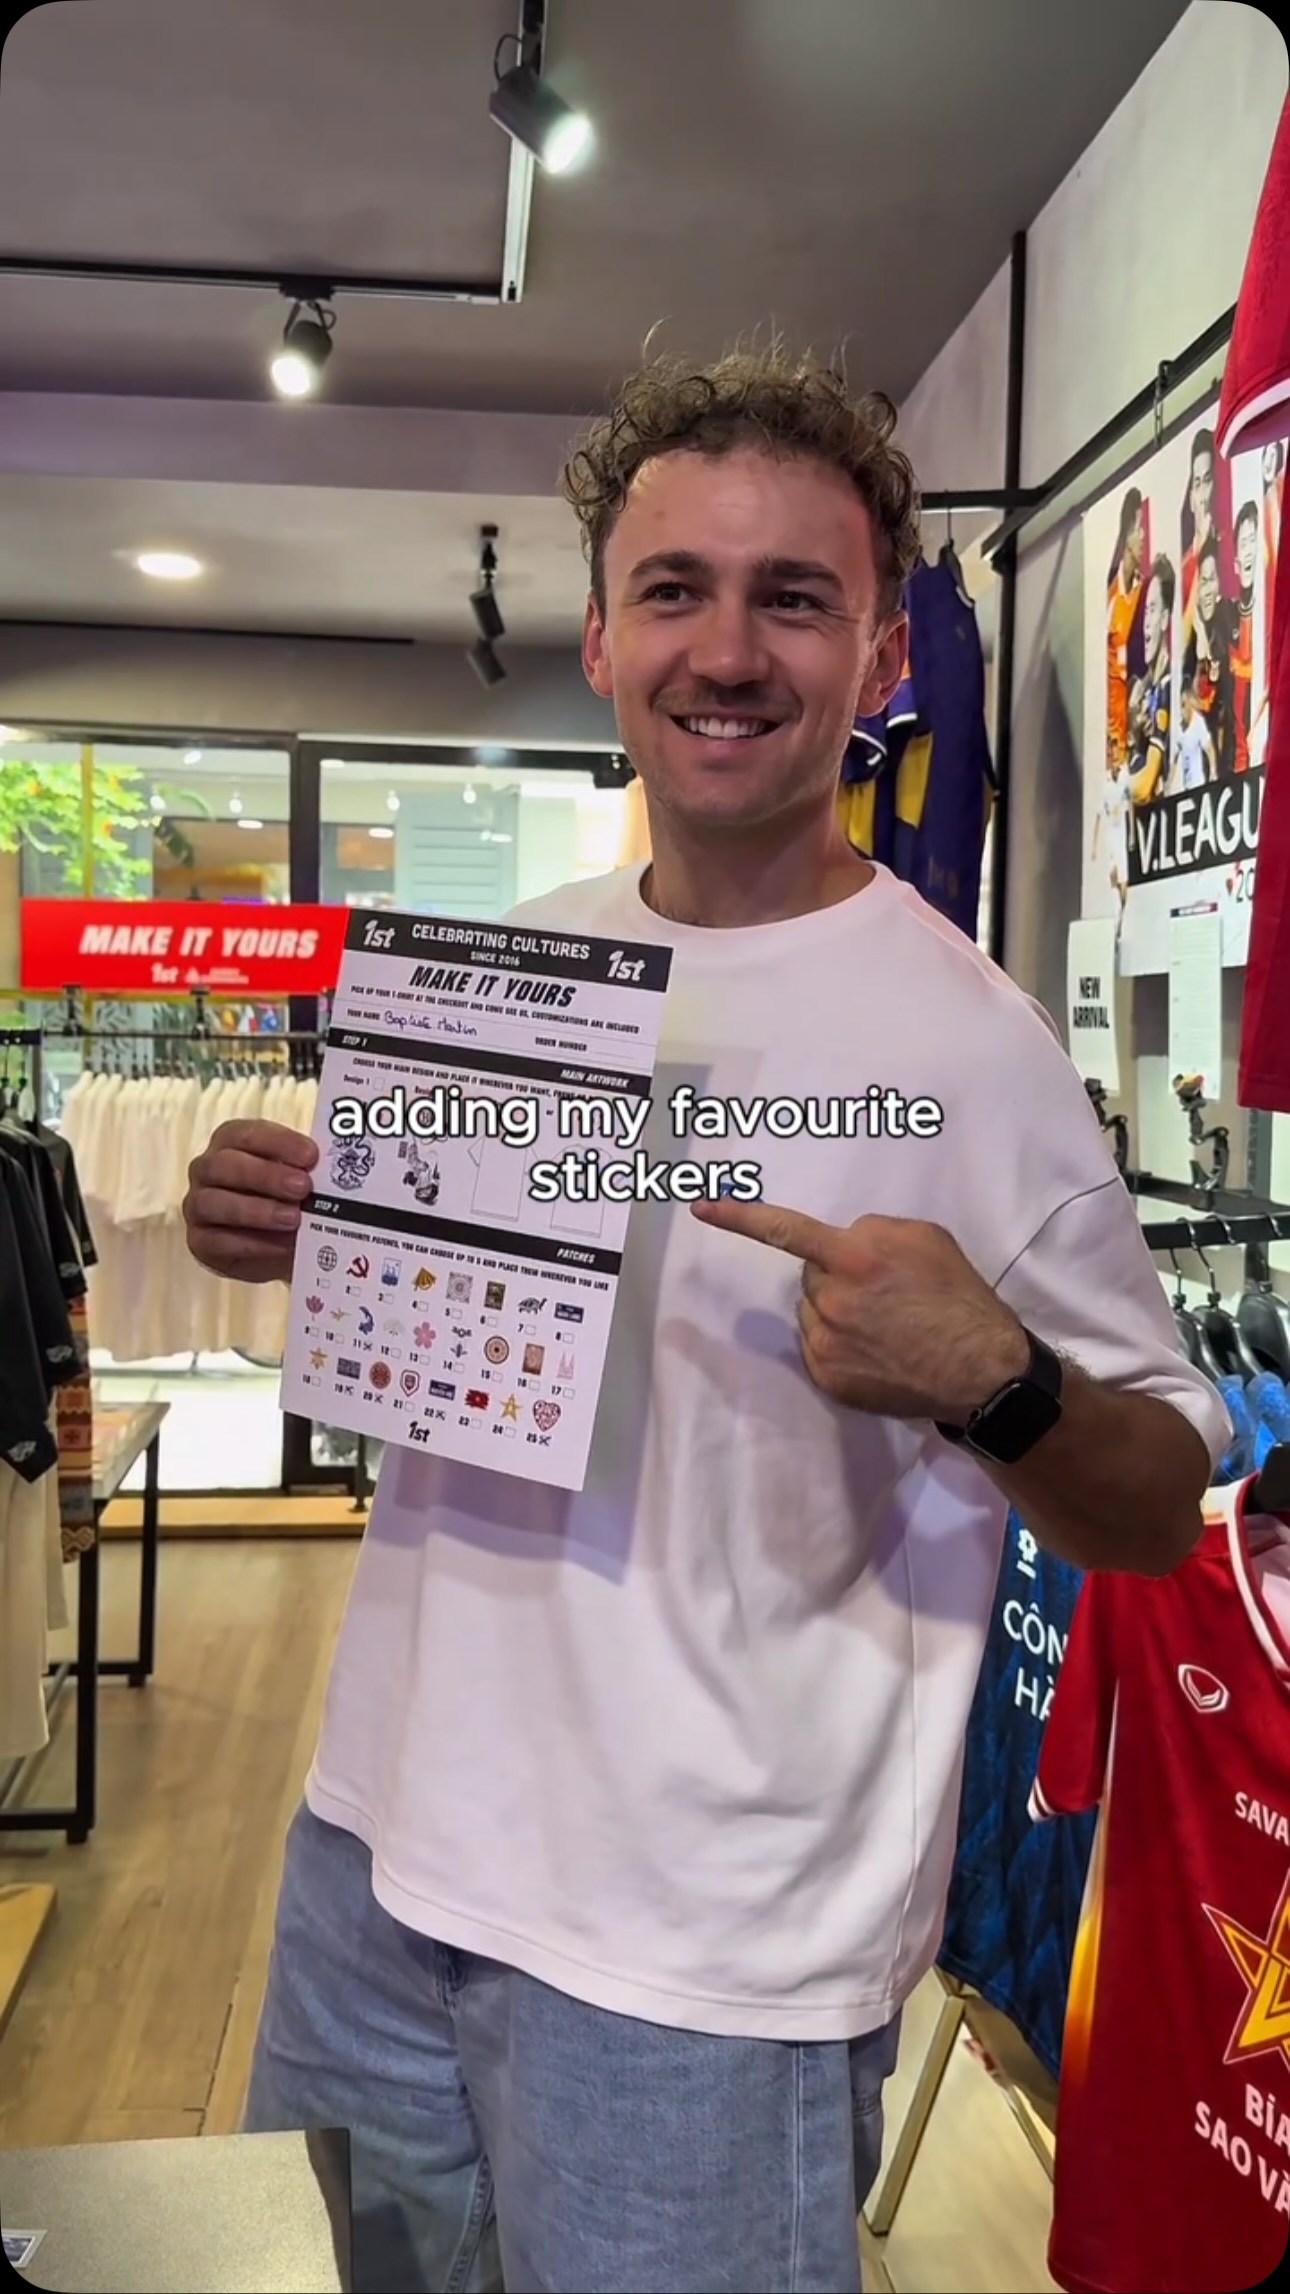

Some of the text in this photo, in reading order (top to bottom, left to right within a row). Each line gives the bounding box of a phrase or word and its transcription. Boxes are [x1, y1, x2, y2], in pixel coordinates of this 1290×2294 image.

[79, 924, 319, 959] MAKE IT YOURS
[363, 919, 396, 949] 1st
[411, 923, 591, 960] CELEBRATING CULTURES
[470, 951, 521, 967] SINCE 2016
[607, 950, 646, 982] 1st
[408, 965, 577, 1008] MAKE IT YOURS
[1079, 975, 1101, 999] NEW
[605, 1021, 640, 1035] INCLUDED
[1073, 1005, 1110, 1029] ARRIVAL
[560, 1068, 630, 1089] MAIN ARTWORK
[314, 1200, 332, 1210] STEP
[556, 1247, 596, 1264] PATCHES
[408, 1420, 431, 1444] 1st
[1194, 2100, 1252, 2177] SAO
